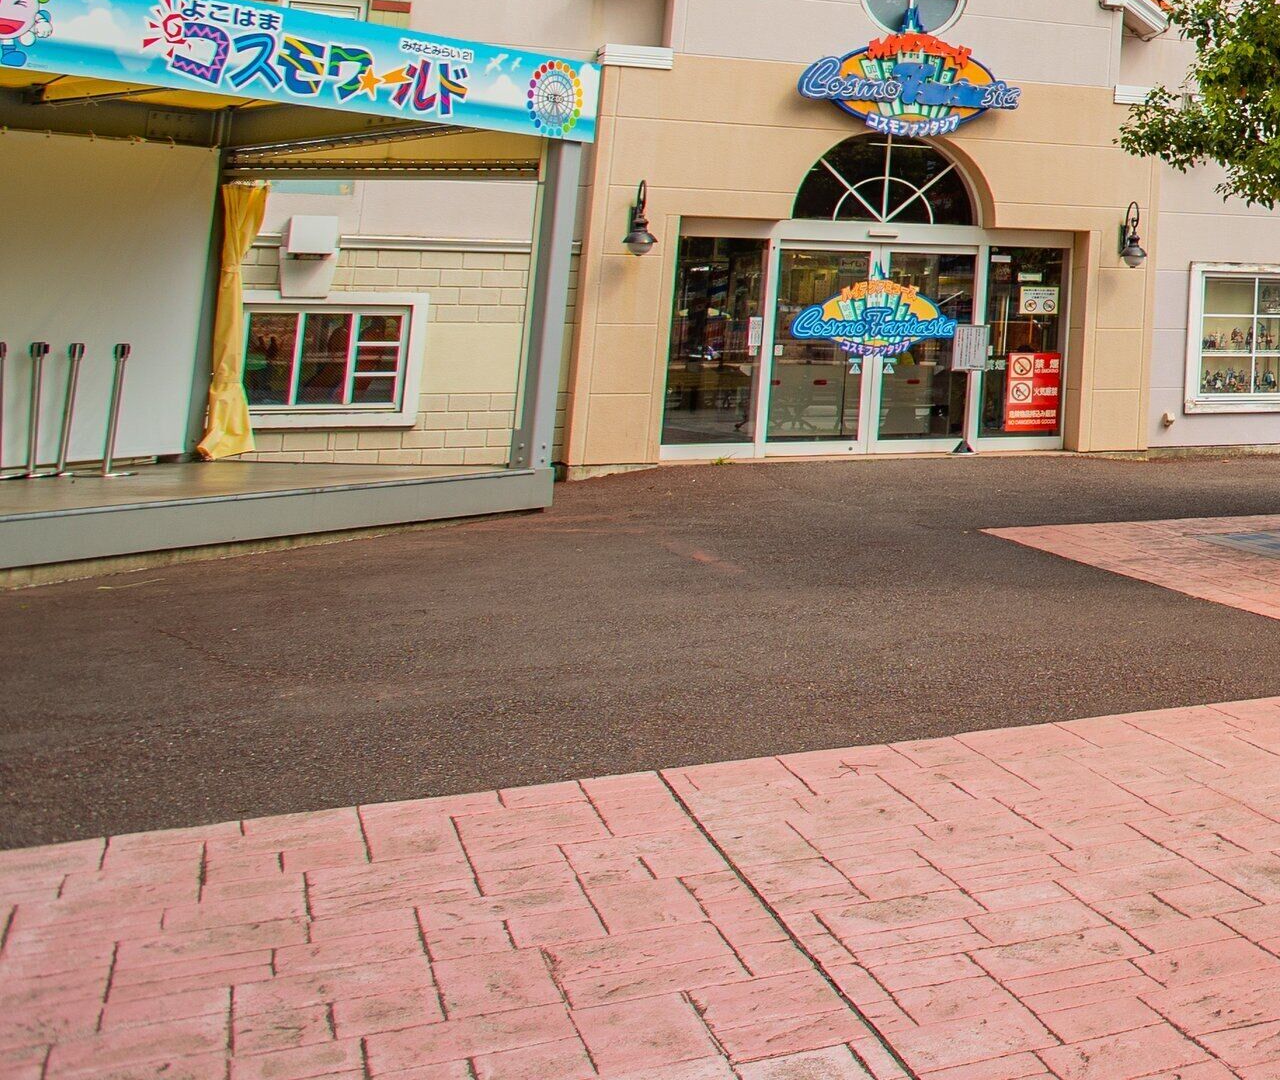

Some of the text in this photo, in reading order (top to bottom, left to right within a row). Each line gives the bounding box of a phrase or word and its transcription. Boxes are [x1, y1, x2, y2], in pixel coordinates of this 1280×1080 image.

[182, 1, 281, 31] よこはま
[171, 22, 469, 115] コスモワールド
[799, 57, 902, 98] Cosmo
[867, 114, 960, 136] コスモファンタジア
[793, 306, 865, 337] Cosmo
[861, 307, 956, 337] Fantasia
[841, 340, 911, 356] コスモファンタジア
